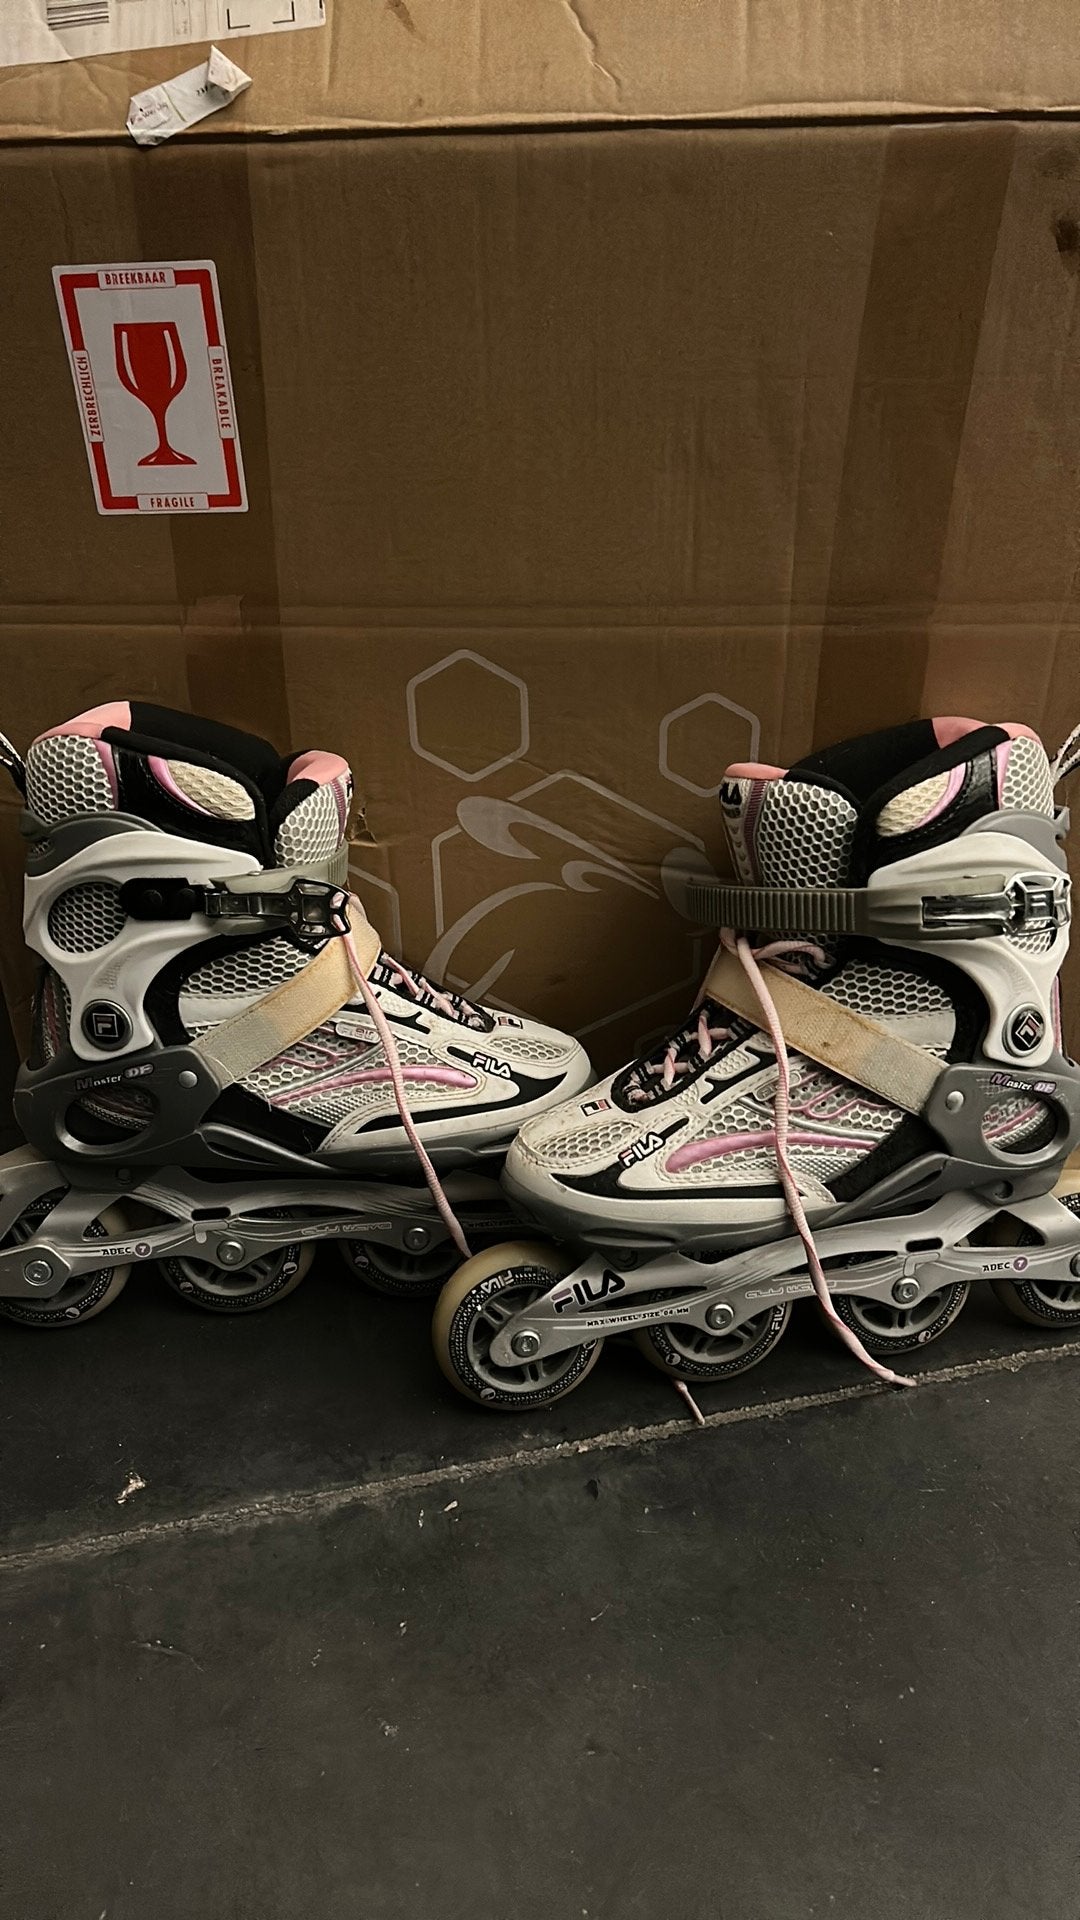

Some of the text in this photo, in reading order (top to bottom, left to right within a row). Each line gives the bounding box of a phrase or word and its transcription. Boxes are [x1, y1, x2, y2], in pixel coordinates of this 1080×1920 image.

[105, 271, 167, 286] BREEKBAAR
[75, 355, 101, 437] ZERBRECHLICH
[212, 357, 232, 429] BREAKABLE
[150, 496, 195, 508] FRAGILE
[472, 1052, 511, 1078] FILA
[991, 1072, 1033, 1091] Master
[619, 1131, 664, 1167] FILA
[551, 1269, 625, 1313] FILA
[586, 1318, 606, 1327] MAX
[608, 1315, 638, 1324] WHEEL
[642, 1312, 660, 1320] SIZE
[676, 1307, 689, 1315] MM
